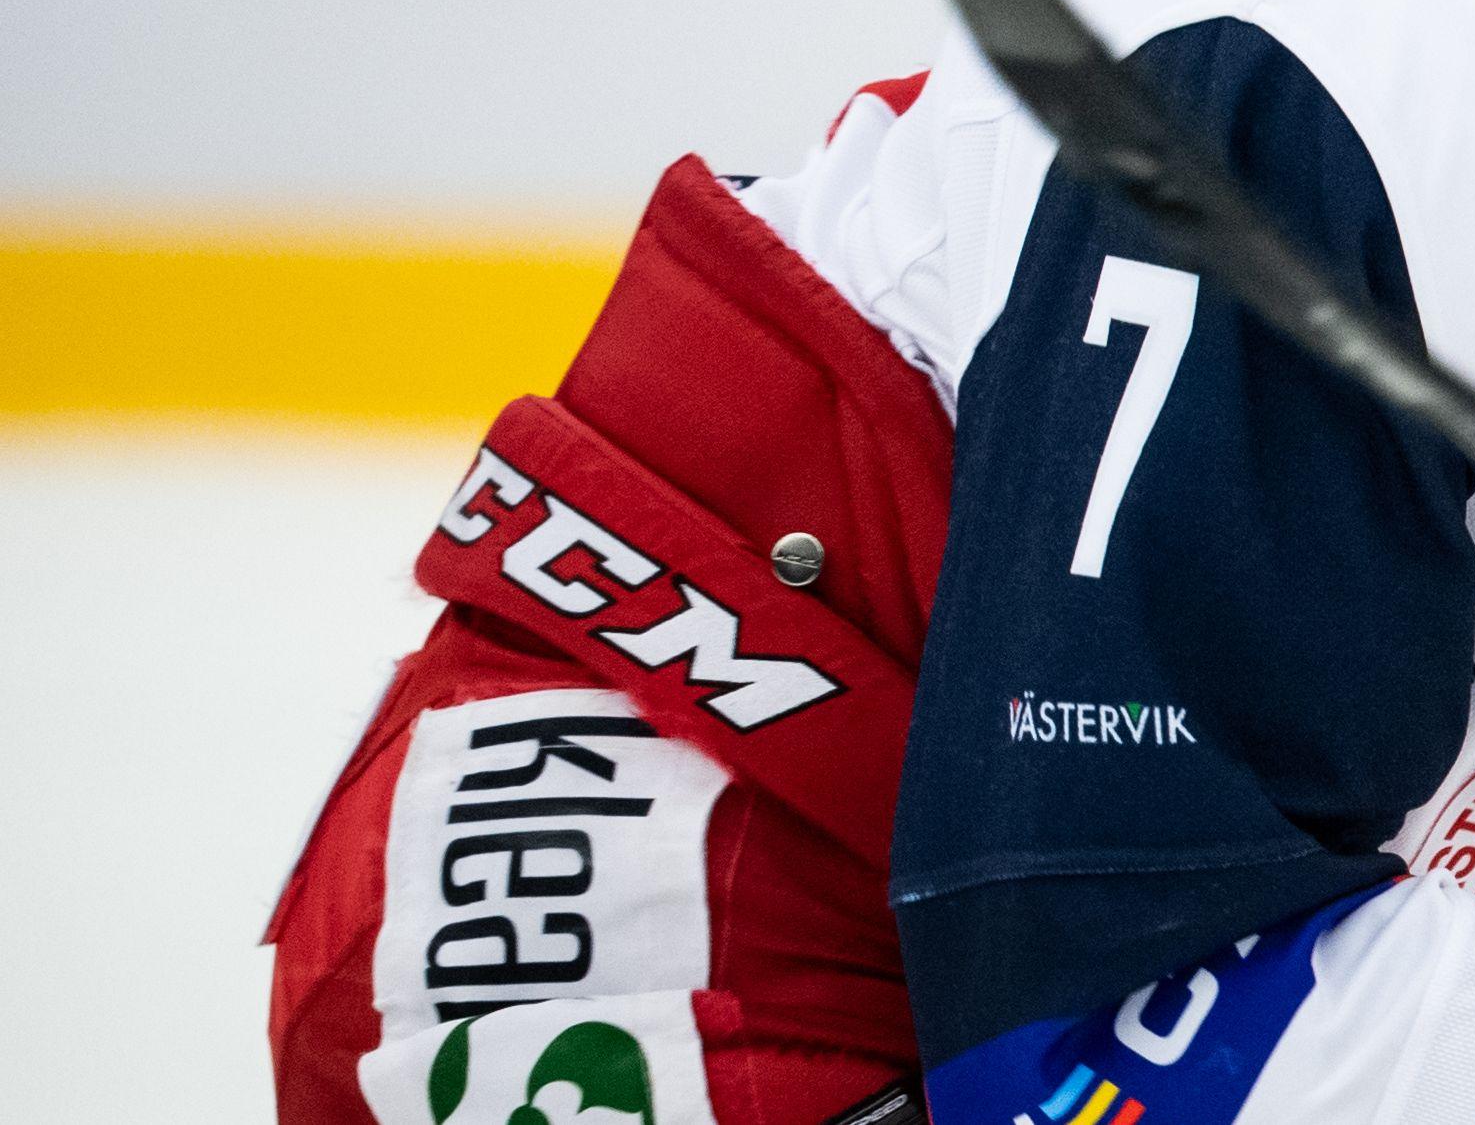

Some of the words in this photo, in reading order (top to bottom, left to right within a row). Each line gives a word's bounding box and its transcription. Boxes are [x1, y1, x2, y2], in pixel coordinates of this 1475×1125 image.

[1070, 254, 1199, 578] 7
[436, 444, 848, 731] CCM
[1009, 690, 1197, 745] VÄSTERVIK
